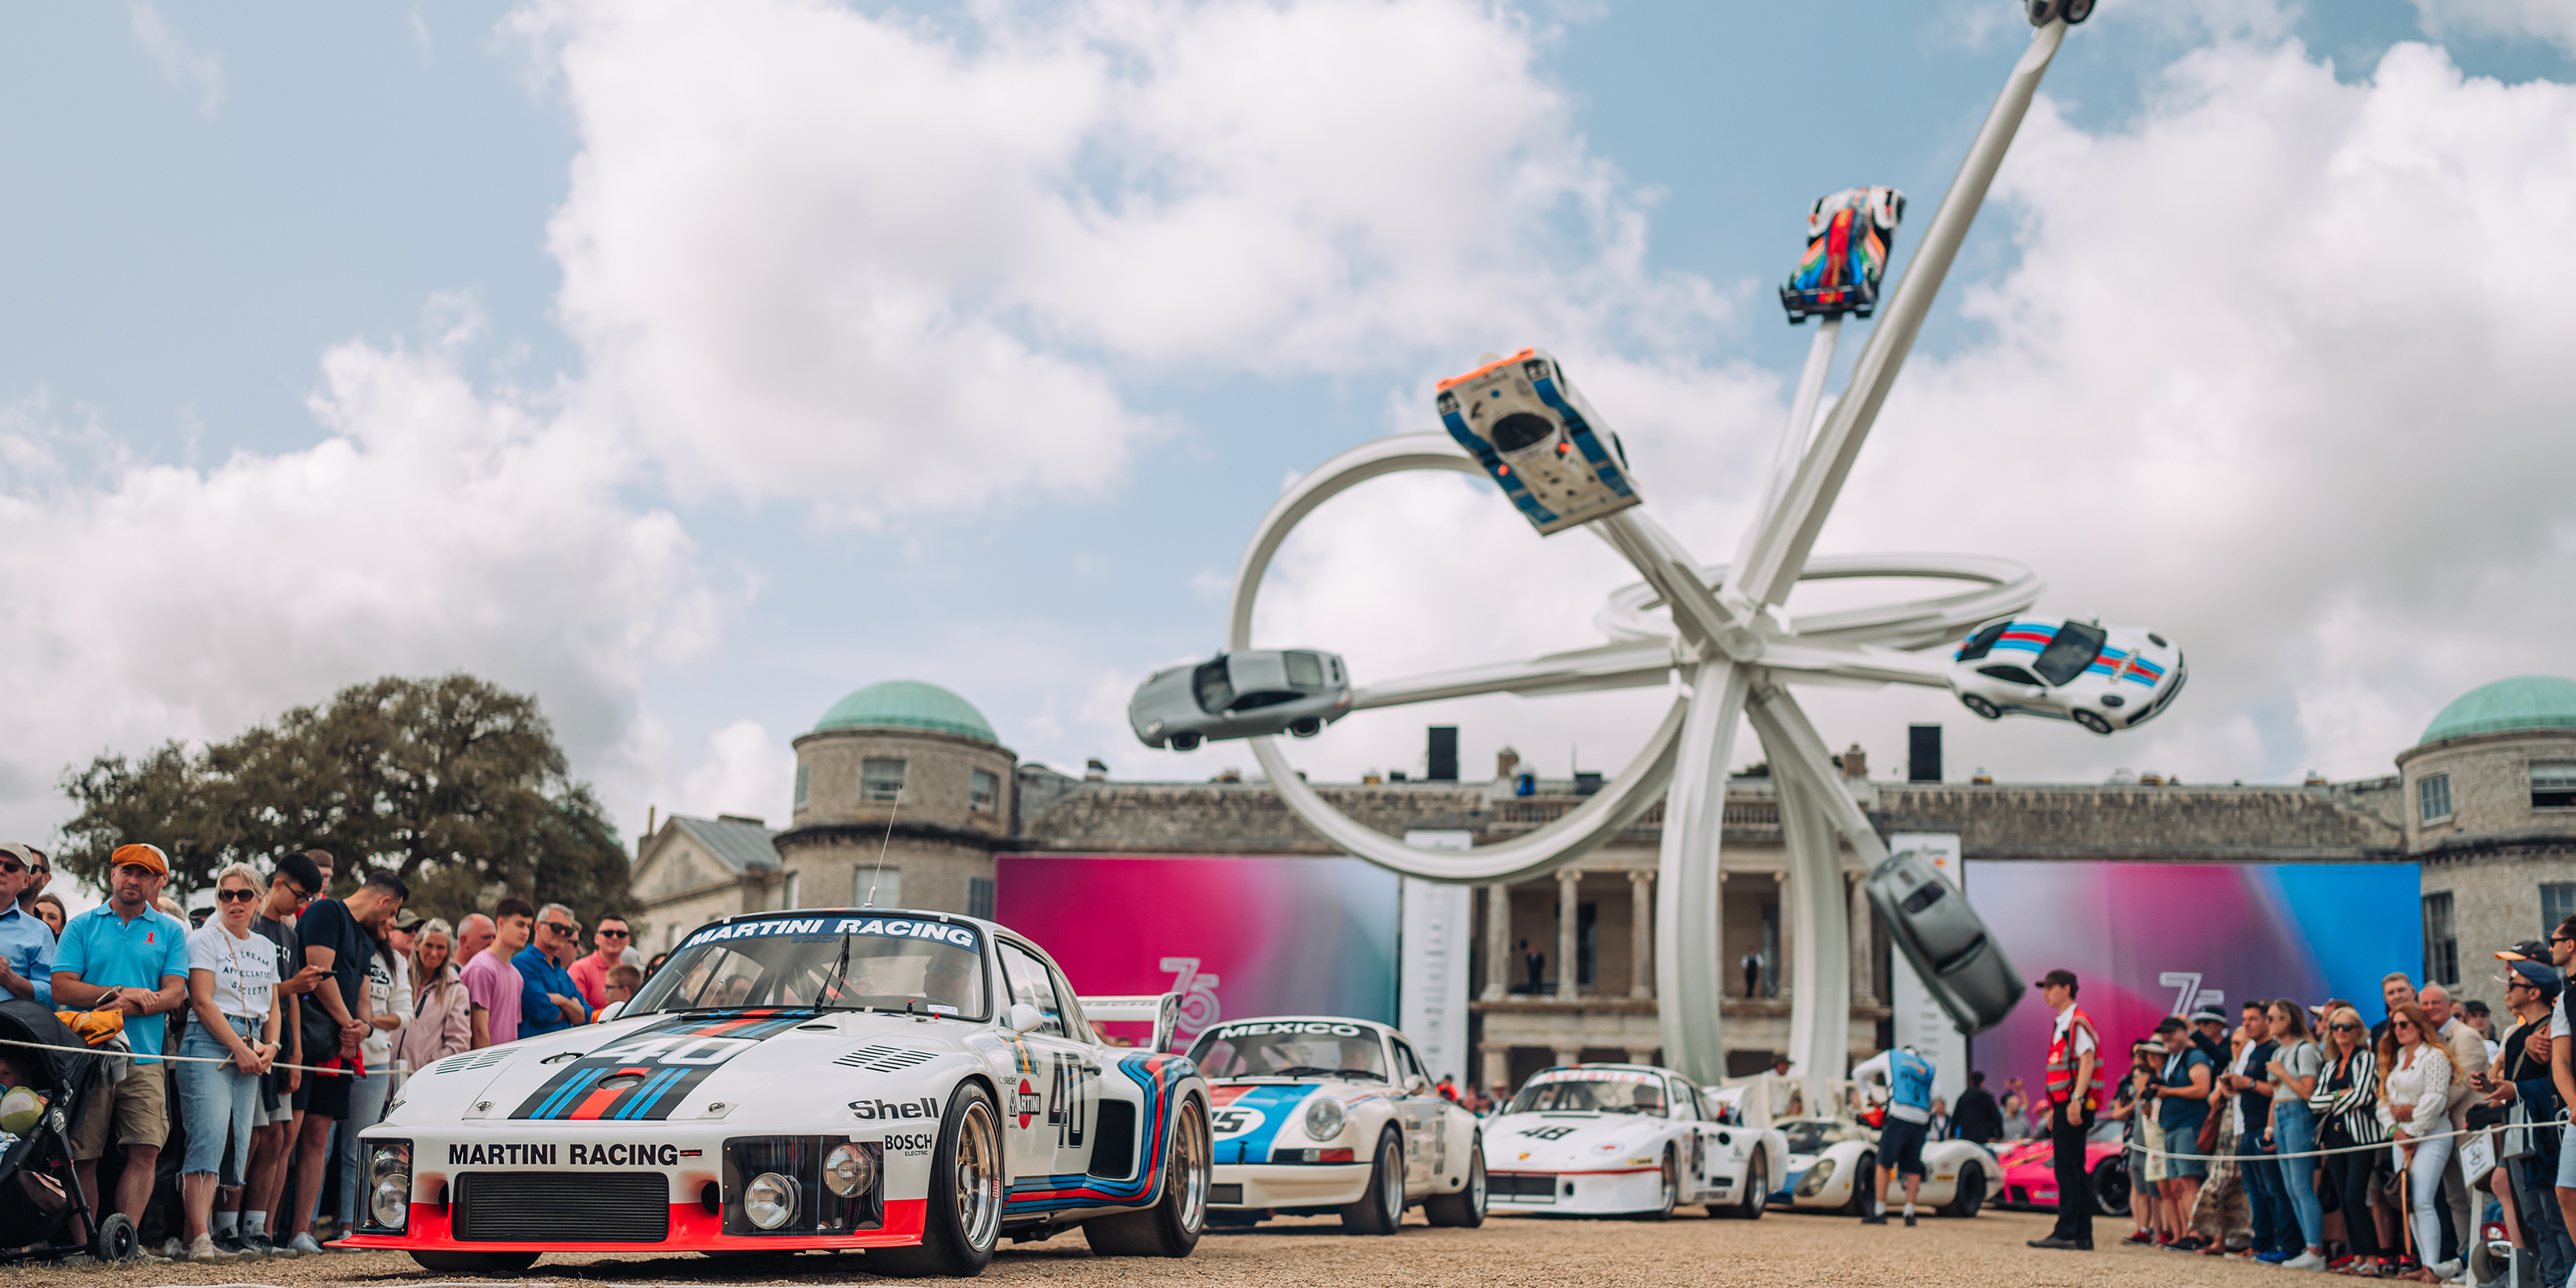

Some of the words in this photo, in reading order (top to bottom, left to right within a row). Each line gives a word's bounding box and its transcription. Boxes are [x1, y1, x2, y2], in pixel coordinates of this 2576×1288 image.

[685, 919, 824, 948] MARTINI
[834, 917, 974, 947] RACING
[791, 935, 841, 943] BOSCH
[1217, 1022, 1360, 1040] MEXICO
[584, 1037, 761, 1066] 40
[848, 1097, 939, 1120] Shell
[1048, 1050, 1084, 1149] 40
[885, 1133, 932, 1150] BOSCH
[1517, 1125, 1578, 1141] 48
[448, 1143, 556, 1165] MARTINI
[569, 1143, 679, 1166] RACING
